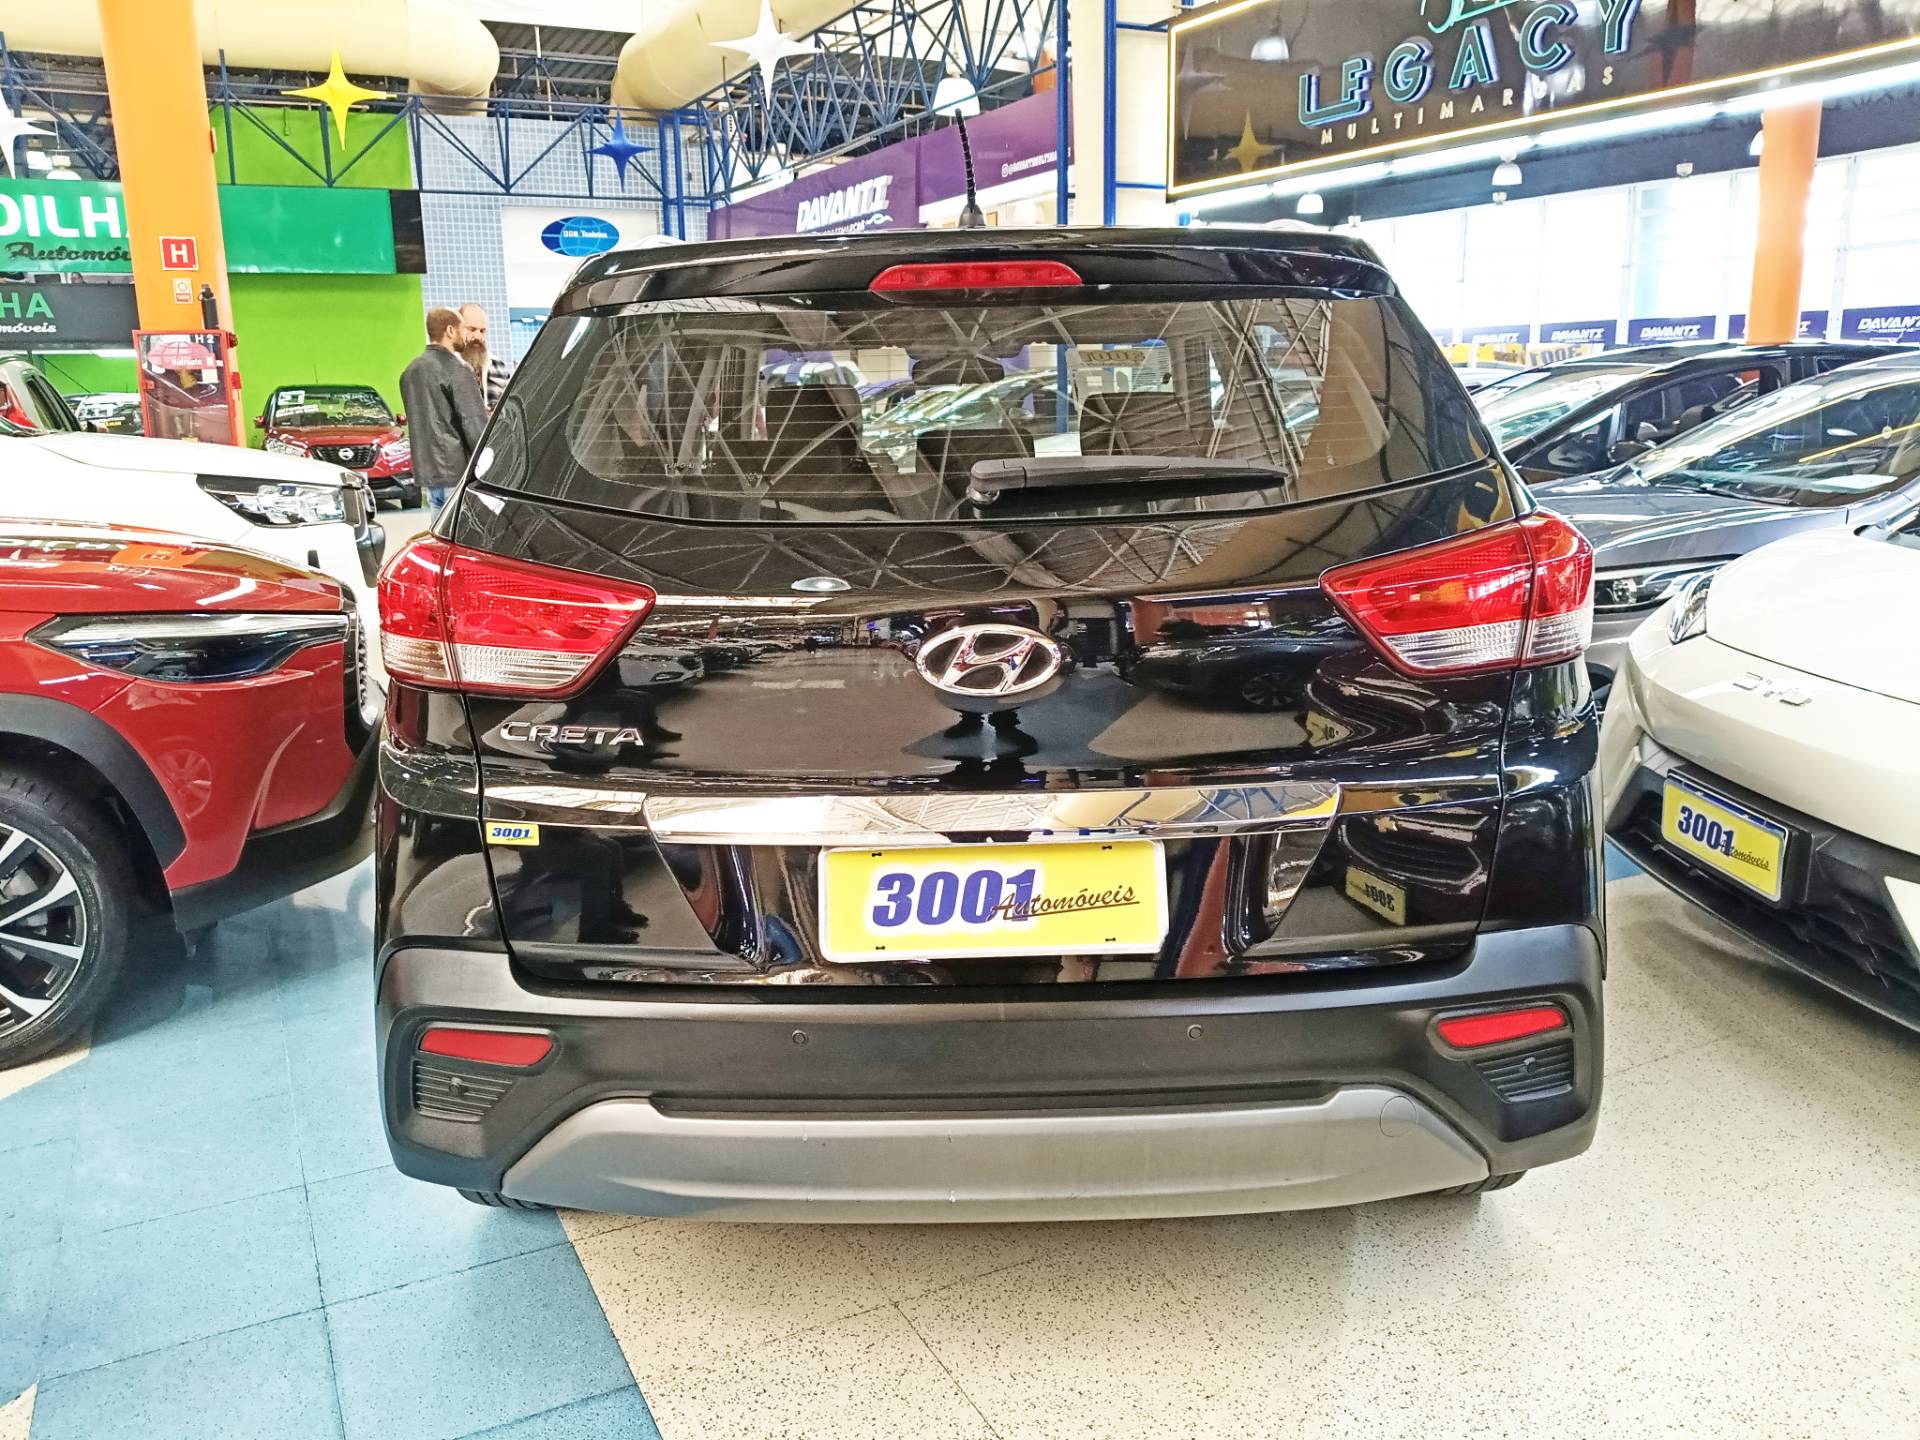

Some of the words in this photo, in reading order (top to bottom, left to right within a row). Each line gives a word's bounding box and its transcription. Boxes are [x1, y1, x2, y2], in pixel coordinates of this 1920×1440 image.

[1298, 0, 1641, 127] LEGACY
[1320, 66, 1614, 146] MULTIMARCAS
[796, 175, 893, 232] DAVANTI
[170, 243, 188, 264] H
[500, 721, 645, 747] CRETA
[492, 827, 530, 838] 3001
[1678, 805, 1735, 857] 3001
[872, 869, 1036, 927] 3001
[985, 884, 1140, 921] Automóveis
